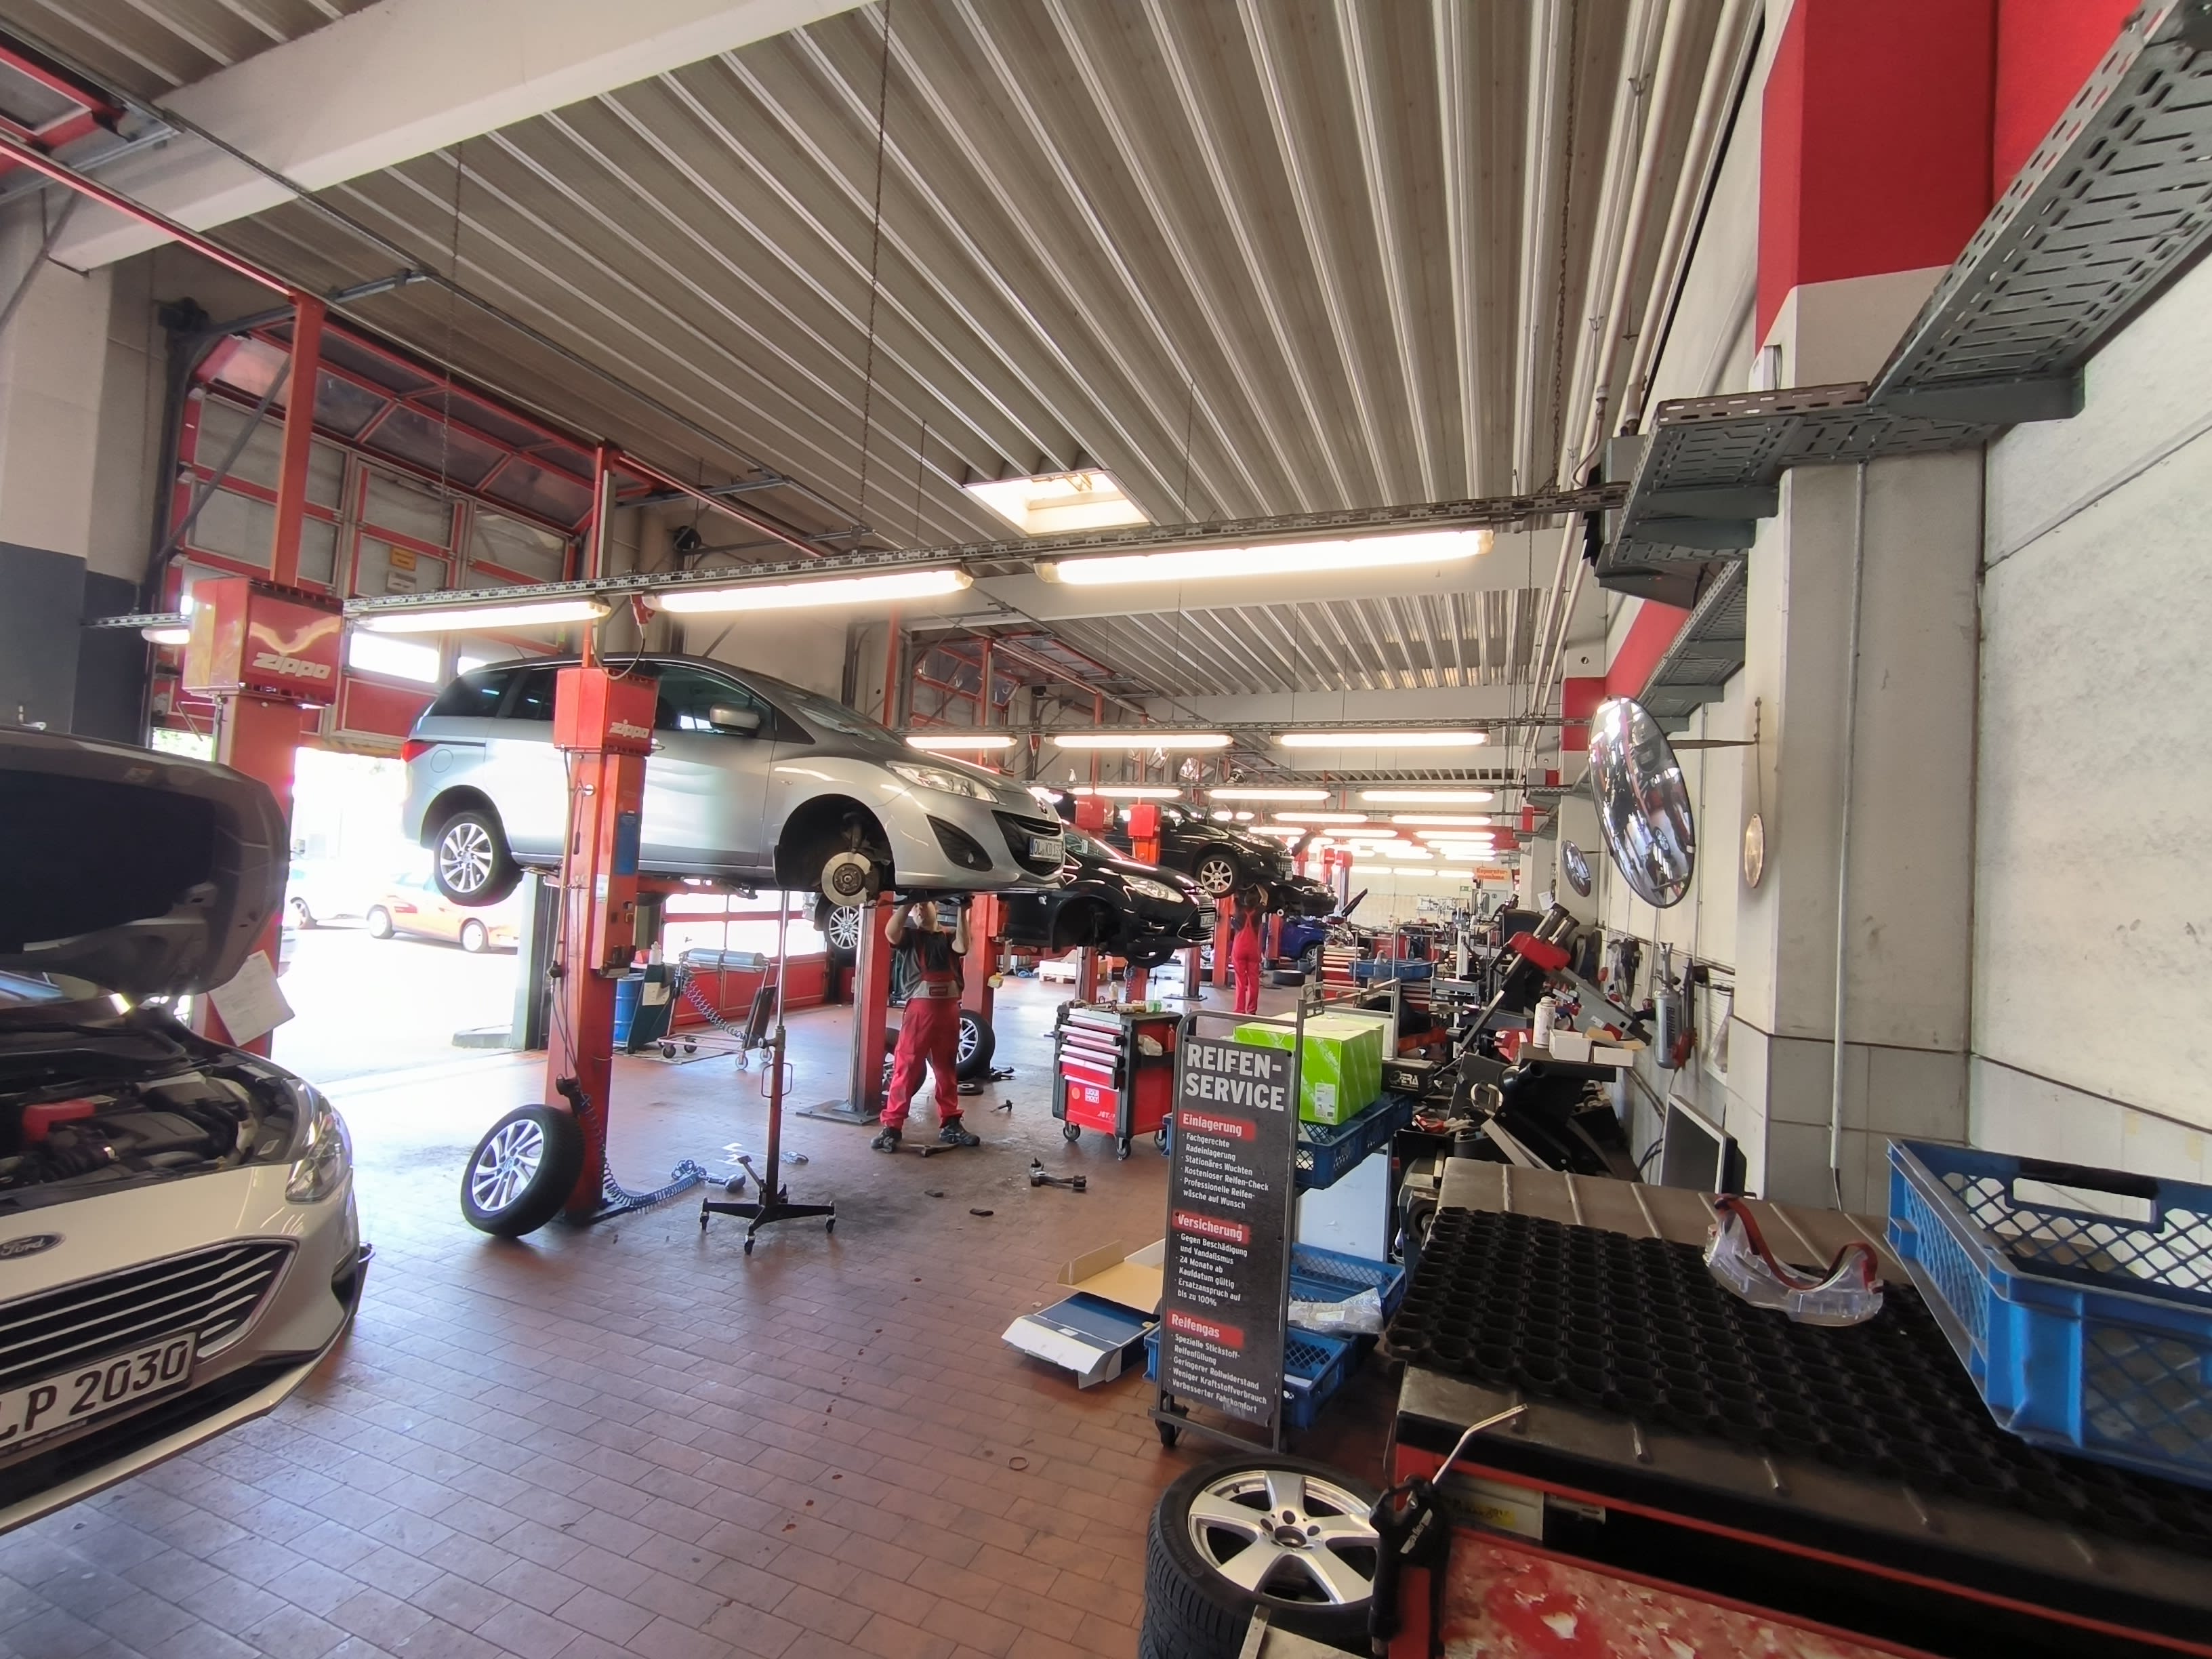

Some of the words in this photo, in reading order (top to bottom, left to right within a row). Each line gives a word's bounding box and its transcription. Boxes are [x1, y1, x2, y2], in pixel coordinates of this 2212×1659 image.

[253, 651, 331, 679] zippo
[609, 719, 650, 739] zippo
[1187, 1044, 1282, 1079] REIFEN-
[1185, 1072, 1284, 1111] SERVICE
[1183, 1113, 1242, 1136] Einlagerung
[1186, 1132, 1230, 1148] Fachgerechte
[1186, 1144, 1236, 1162] Radeinlagerung
[1185, 1155, 1223, 1170] Stationäres
[1224, 1163, 1253, 1176] Wuchten
[1184, 1177, 1230, 1194] Professionelle
[1231, 1187, 1255, 1200] Reifen-
[1185, 1166, 1223, 1181] Kostenloser
[1225, 1174, 1269, 1191] Reifen-Check
[1183, 1189, 1206, 1201] wäsche
[1208, 1195, 1219, 1204] auf
[1221, 1197, 1246, 1209] Wunsch
[1178, 1214, 1242, 1242] Versicherung
[1, 1237, 45, 1255] Ford
[1180, 1245, 1192, 1254] und
[1194, 1248, 1233, 1265] Vandalismus
[1181, 1233, 1201, 1245] Gegen
[1202, 1237, 1248, 1257] Beschädigung
[1179, 1256, 1188, 1264] 24
[1189, 1258, 1213, 1271] Monate
[1215, 1265, 1223, 1273] ab
[1179, 1267, 1213, 1283] Kaufdatum
[1215, 1276, 1235, 1289] gültig
[1177, 1289, 1187, 1298] bis
[1198, 1294, 1217, 1307] 100%
[1178, 1278, 1229, 1299] Ersatzanspruch
[1230, 1293, 1242, 1302] auf
[1172, 1313, 1220, 1338] Reifengas
[1174, 1334, 1204, 1349] Spezielle
[1205, 1341, 1241, 1359] Stickstoff-
[1174, 1345, 1216, 1365] Reifenfüllung
[68, 1339, 189, 1416] 2030
[1173, 1356, 1208, 1374] Geringerer
[1210, 1367, 1259, 1390] Rollwiderstand
[1172, 1367, 1199, 1383] Weniger
[1200, 1374, 1267, 1405] Kraftstoffverbrauch
[1172, 1378, 1214, 1399] Verbesserter
[1216, 1392, 1257, 1414] Fahrkomfort
